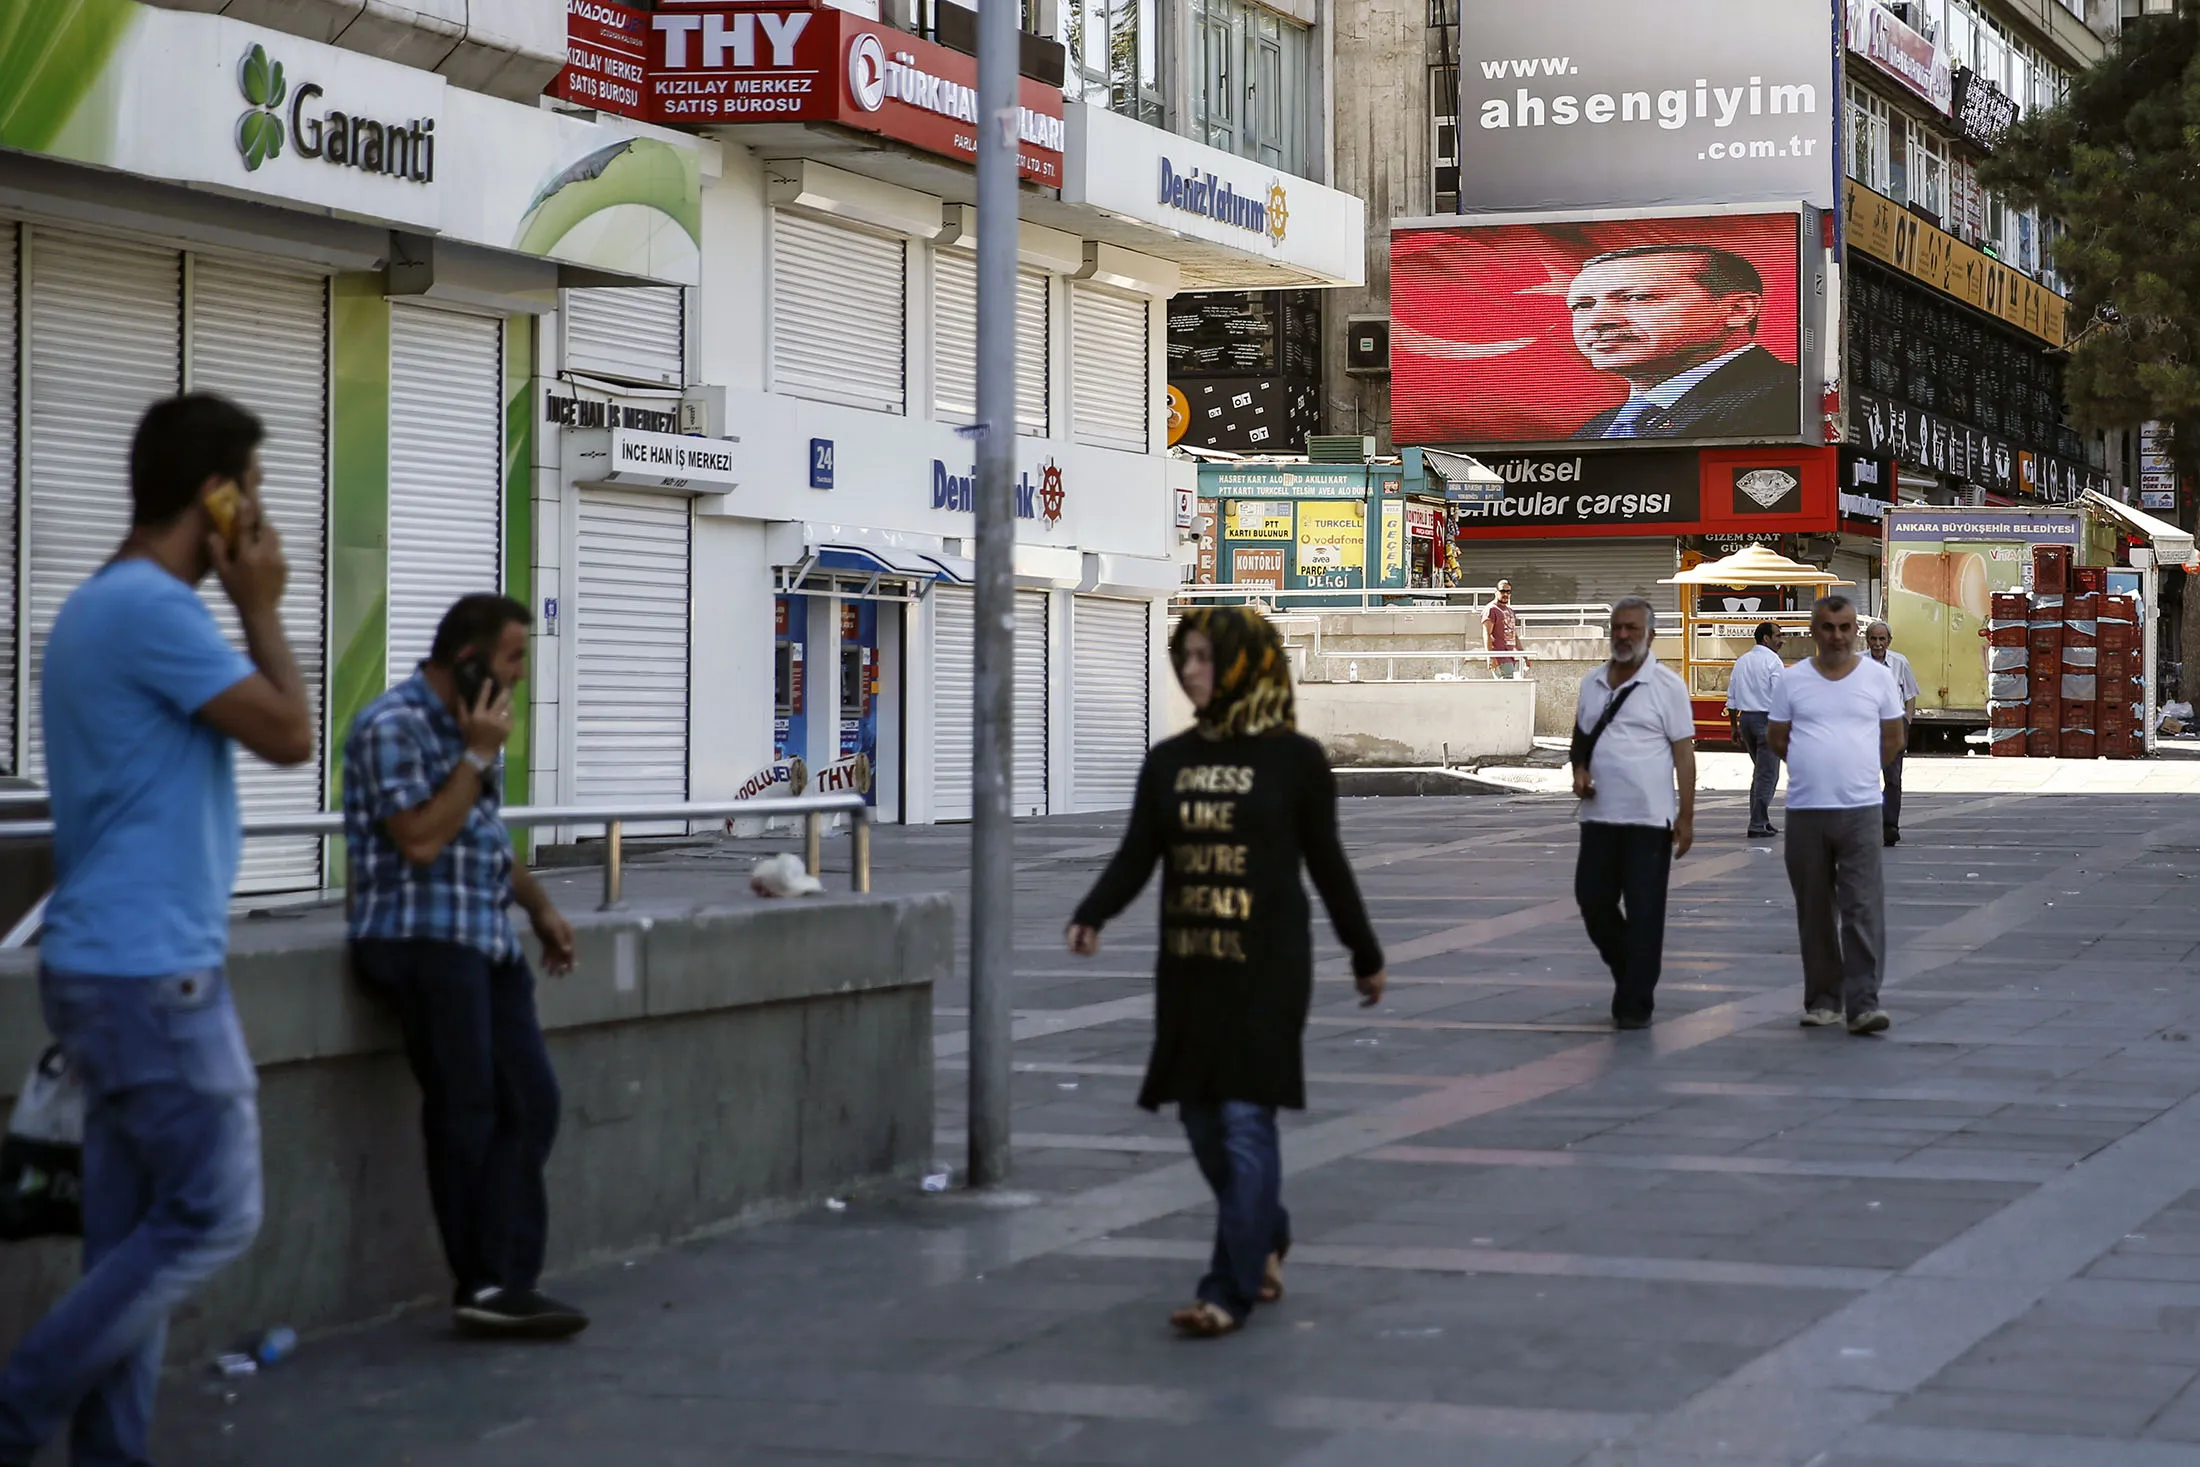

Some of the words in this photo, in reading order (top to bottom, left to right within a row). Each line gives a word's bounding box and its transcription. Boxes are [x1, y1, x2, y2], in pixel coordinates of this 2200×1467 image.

[652, 13, 812, 68] THY
[567, 47, 602, 72] KIZILAY
[604, 57, 643, 84] MERKEZ
[1480, 56, 1578, 80] www.
[570, 72, 598, 100] SATIŞ
[599, 80, 638, 107] BÜROSU
[655, 81, 728, 95] KIZILAY
[734, 79, 812, 93] MERKEZ
[886, 51, 941, 113] TÜRK
[941, 80, 980, 124] HAV
[664, 99, 718, 116] SATIŞ
[724, 95, 801, 113] BÜROSU
[1480, 76, 1816, 129] ahsengiyim
[288, 80, 436, 184] Garanti
[953, 133, 978, 153] PARLA
[1697, 135, 1817, 160] .com.tr
[1159, 156, 1264, 234] DenizYatırım
[622, 439, 647, 462] İNCE
[650, 445, 673, 465] HAN
[675, 445, 686, 470] İŞ
[688, 451, 732, 472] MERKEZİ
[816, 446, 833, 470] 24
[1219, 475, 1246, 484] HASRET
[1247, 475, 1267, 484] KART
[1270, 475, 1283, 484] ALO
[1328, 476, 1348, 484] KART
[1219, 487, 1231, 495] PTT
[1233, 486, 1254, 495] KARTI
[1257, 486, 1289, 495] TURKCELL
[1319, 487, 1335, 495] AVEA
[1338, 487, 1351, 495] ALO
[1352, 485, 1374, 496] DÜNA
[1576, 492, 1671, 519] çarşısı
[1229, 529, 1251, 537] KARTI
[1265, 520, 1279, 528] PTT
[1315, 520, 1363, 528] TURKCELL
[1895, 523, 1940, 532] ANKARA
[1942, 522, 2011, 534] BÜYÜKŞEHİR
[2013, 523, 2075, 534] BELEDİYESİ
[1314, 534, 1364, 545] vodafone
[1747, 533, 1781, 541] SAAT
[1236, 552, 1281, 570] KONTÖRLÜ
[816, 764, 857, 793] THY
[1174, 765, 1255, 794] DRESS
[1179, 801, 1236, 832] LIKE
